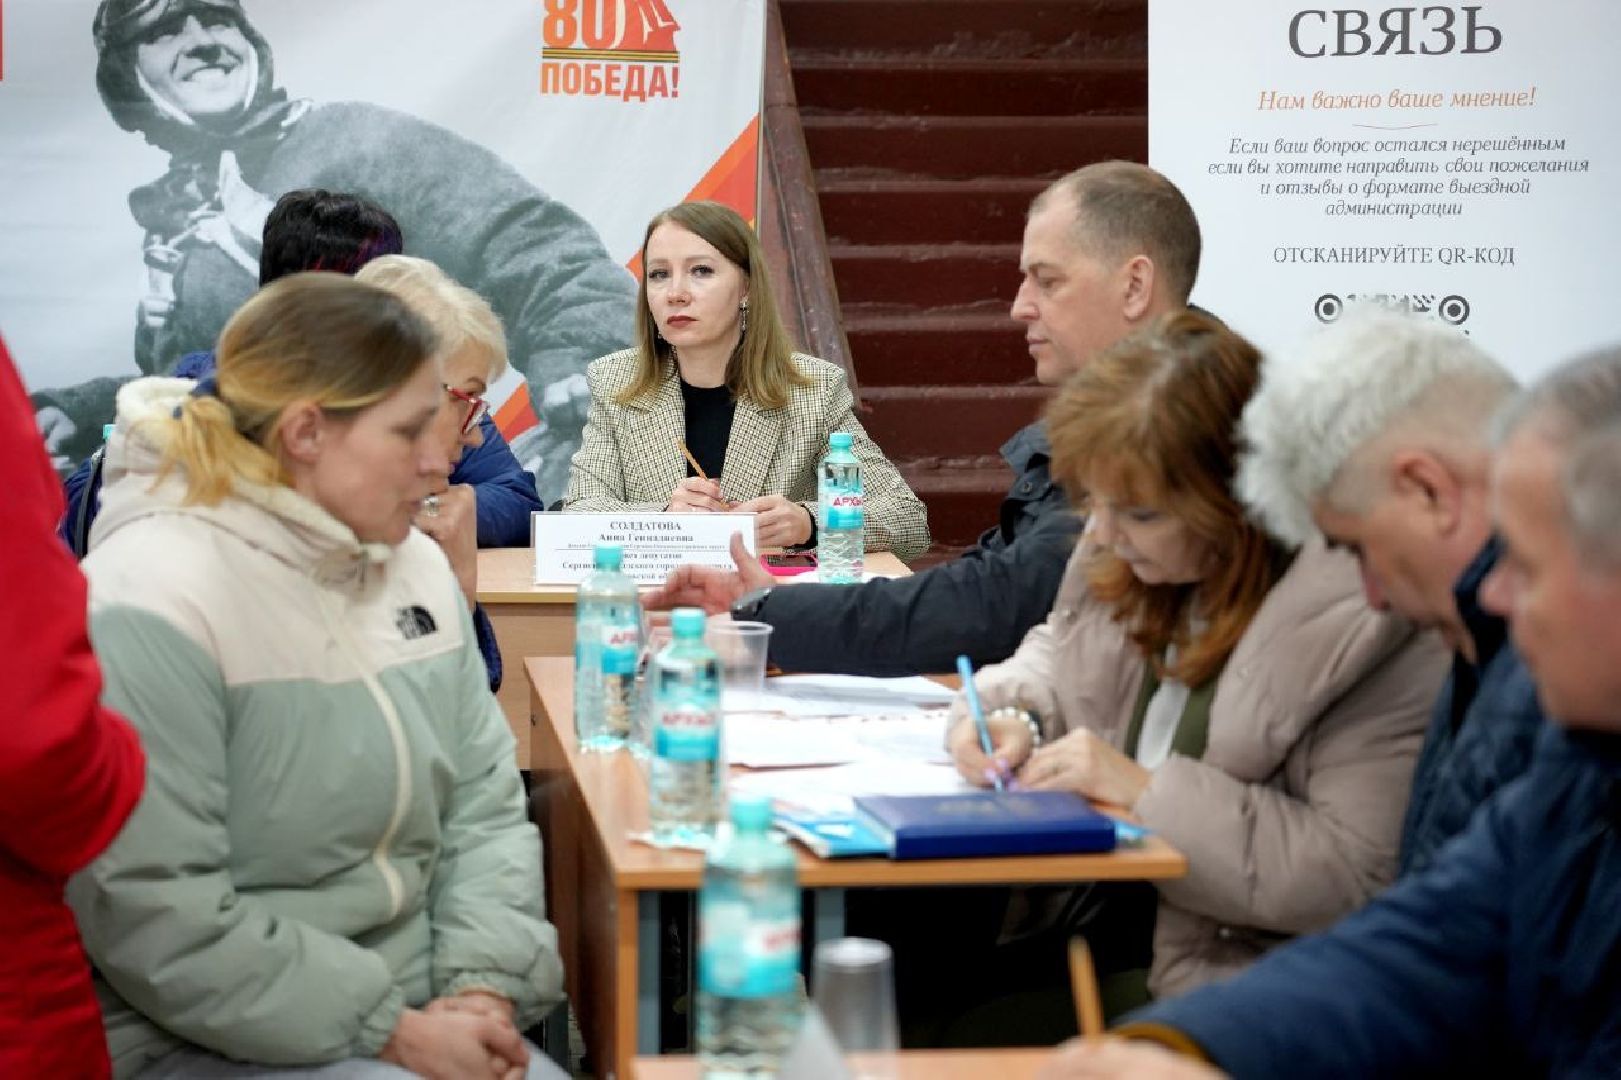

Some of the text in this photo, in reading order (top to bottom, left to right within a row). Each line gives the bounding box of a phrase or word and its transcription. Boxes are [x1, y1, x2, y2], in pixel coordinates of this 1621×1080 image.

[1289, 6, 1502, 58] СВЯЗЬ
[540, 62, 680, 102] ПОБЕДА!
[1258, 87, 1537, 110] Нам важно ваше мнение!
[1229, 136, 1566, 156] Если ваш вопрос остался нерешённым
[1208, 158, 1589, 177] если вы хотите направить свои пожелания
[1260, 177, 1530, 198] и отзывы о формате выездной
[1325, 200, 1463, 219] администрации
[1274, 244, 1515, 266] ОТСКАНИРУЙТЕ QR-КОД
